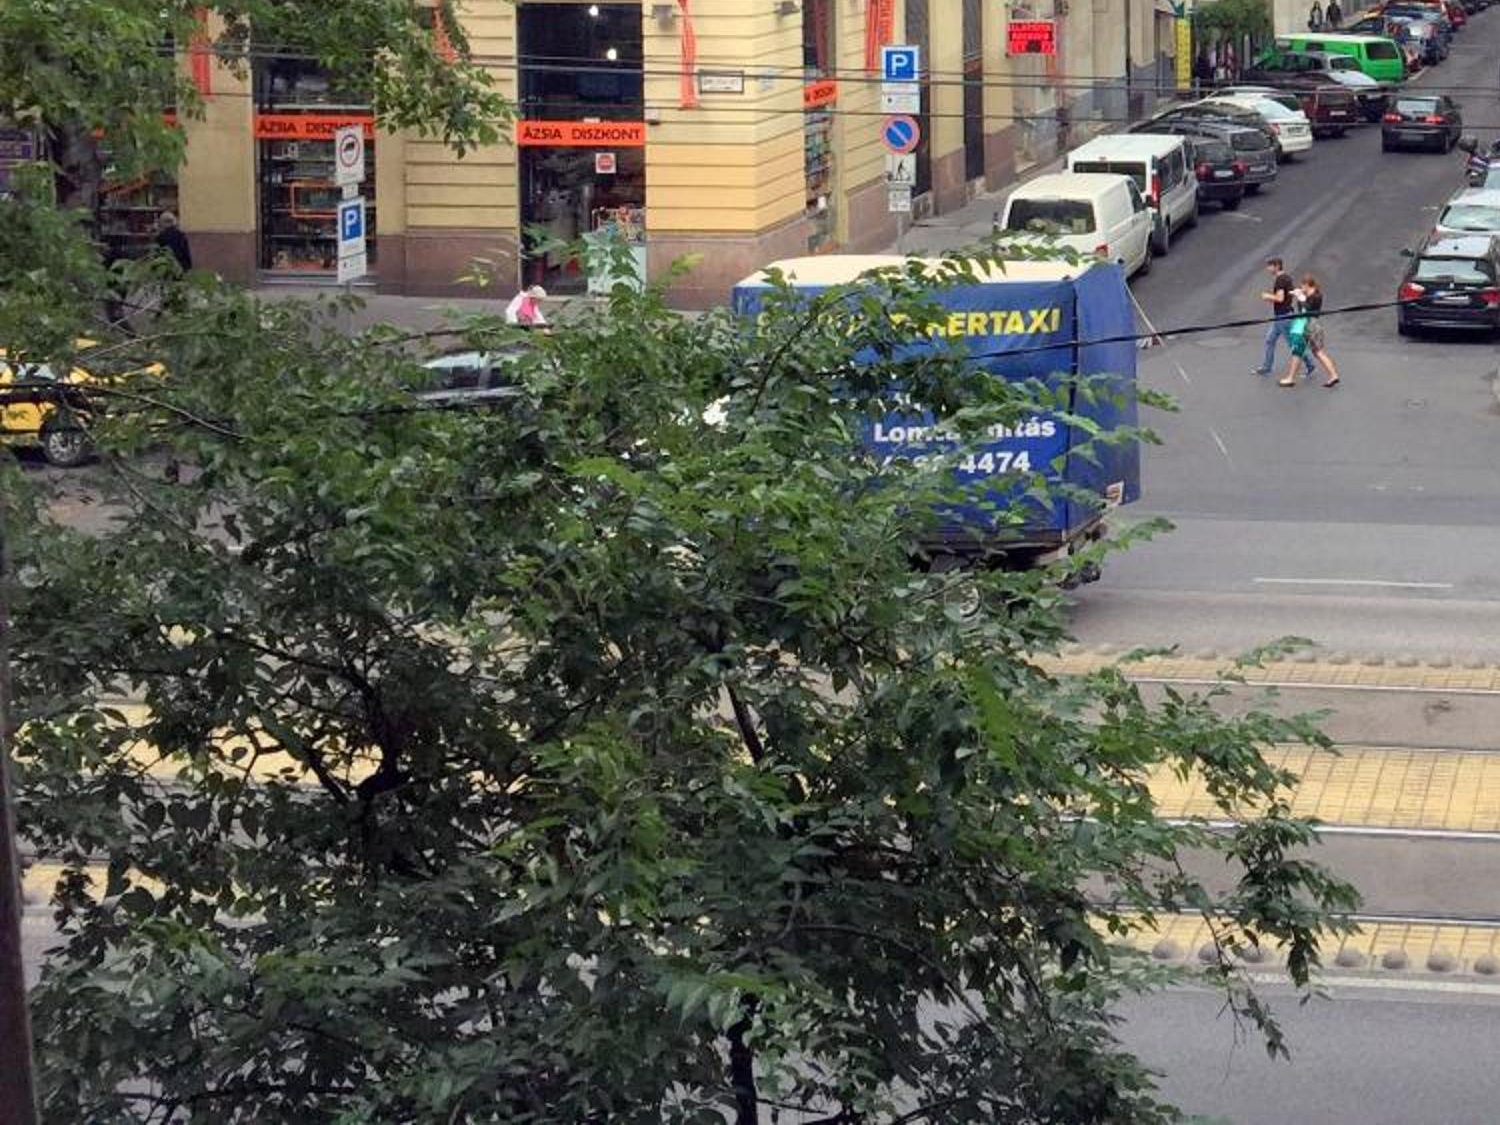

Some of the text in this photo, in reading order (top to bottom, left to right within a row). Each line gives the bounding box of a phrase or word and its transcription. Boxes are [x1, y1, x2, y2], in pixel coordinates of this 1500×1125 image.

[891, 53, 909, 76] P
[571, 128, 640, 140] DISZKONT
[344, 207, 358, 236] P
